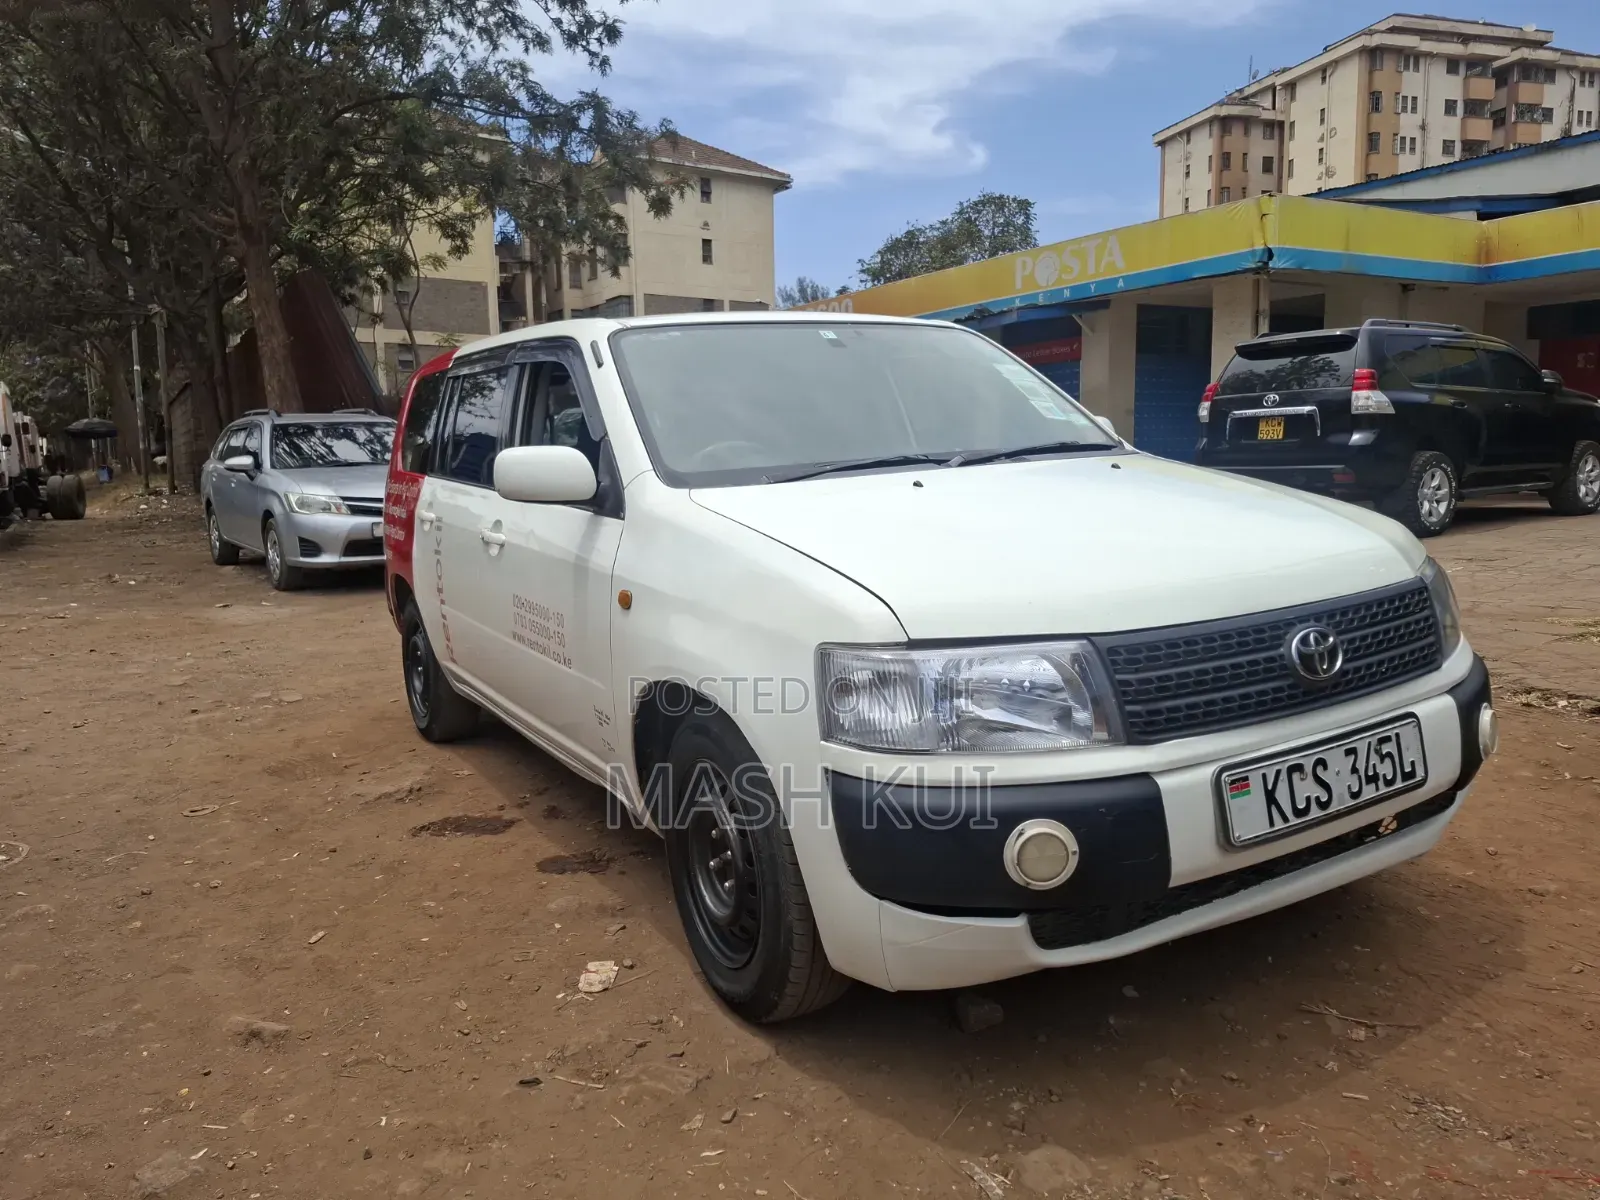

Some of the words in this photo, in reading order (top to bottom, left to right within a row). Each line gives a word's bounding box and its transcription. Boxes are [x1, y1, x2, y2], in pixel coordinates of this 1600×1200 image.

[1015, 235, 1125, 290] POSTA
[1015, 278, 1124, 306] KENYA
[1259, 428, 1282, 439] 593V
[1264, 417, 1283, 428] KCW
[1261, 757, 1333, 828] KCS
[1344, 731, 1417, 800] 345L
